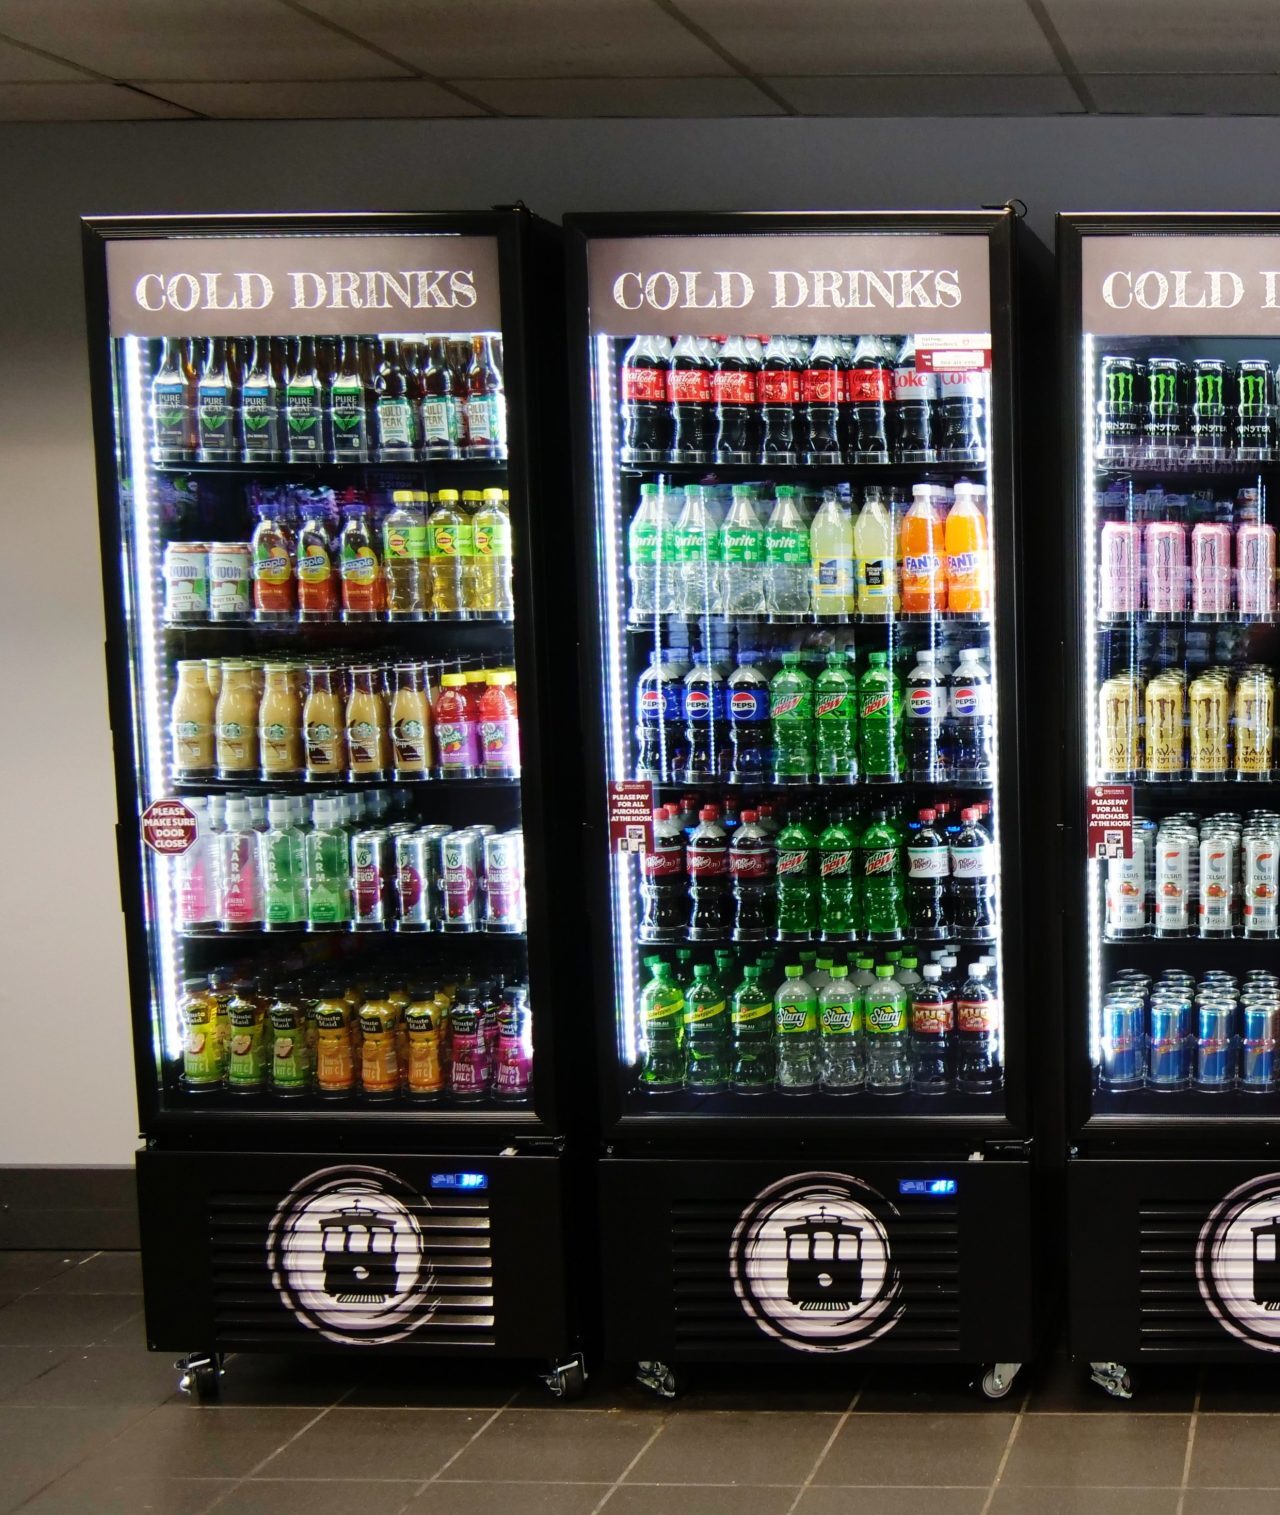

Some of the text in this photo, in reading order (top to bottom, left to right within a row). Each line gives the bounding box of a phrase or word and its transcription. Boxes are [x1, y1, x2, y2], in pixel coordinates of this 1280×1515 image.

[136, 270, 478, 311] COLD DRINKS
[613, 270, 962, 310] COLD DRINKS
[1102, 270, 1245, 310] COLD
[895, 373, 928, 387] Coke
[1104, 422, 1137, 430] MONSTER
[1144, 422, 1180, 431] MONSTER
[1190, 422, 1228, 432] MONSTER
[1235, 424, 1271, 434] MONSTER
[632, 535, 663, 547] Sprite
[674, 535, 704, 547] Sprite
[724, 535, 756, 547] Sprite
[766, 536, 796, 549] Sprite
[256, 558, 286, 569] apple
[297, 556, 324, 567] apple
[344, 558, 374, 570] apple
[906, 556, 940, 569] FANTA
[947, 554, 980, 568] FANTA
[1148, 744, 1176, 756] JAVA
[1242, 746, 1272, 756] JAVA
[152, 808, 185, 816] PLEASE
[144, 818, 196, 827] MAKE SURE
[156, 829, 184, 838] DOOR
[155, 840, 188, 848] CLOSES
[777, 1010, 807, 1026] Starry
[822, 1010, 854, 1026] Starry
[870, 1010, 902, 1026] Starry
[916, 1010, 946, 1019] MUG
[960, 1009, 988, 1018] MUG
[318, 1020, 338, 1028] Maid
